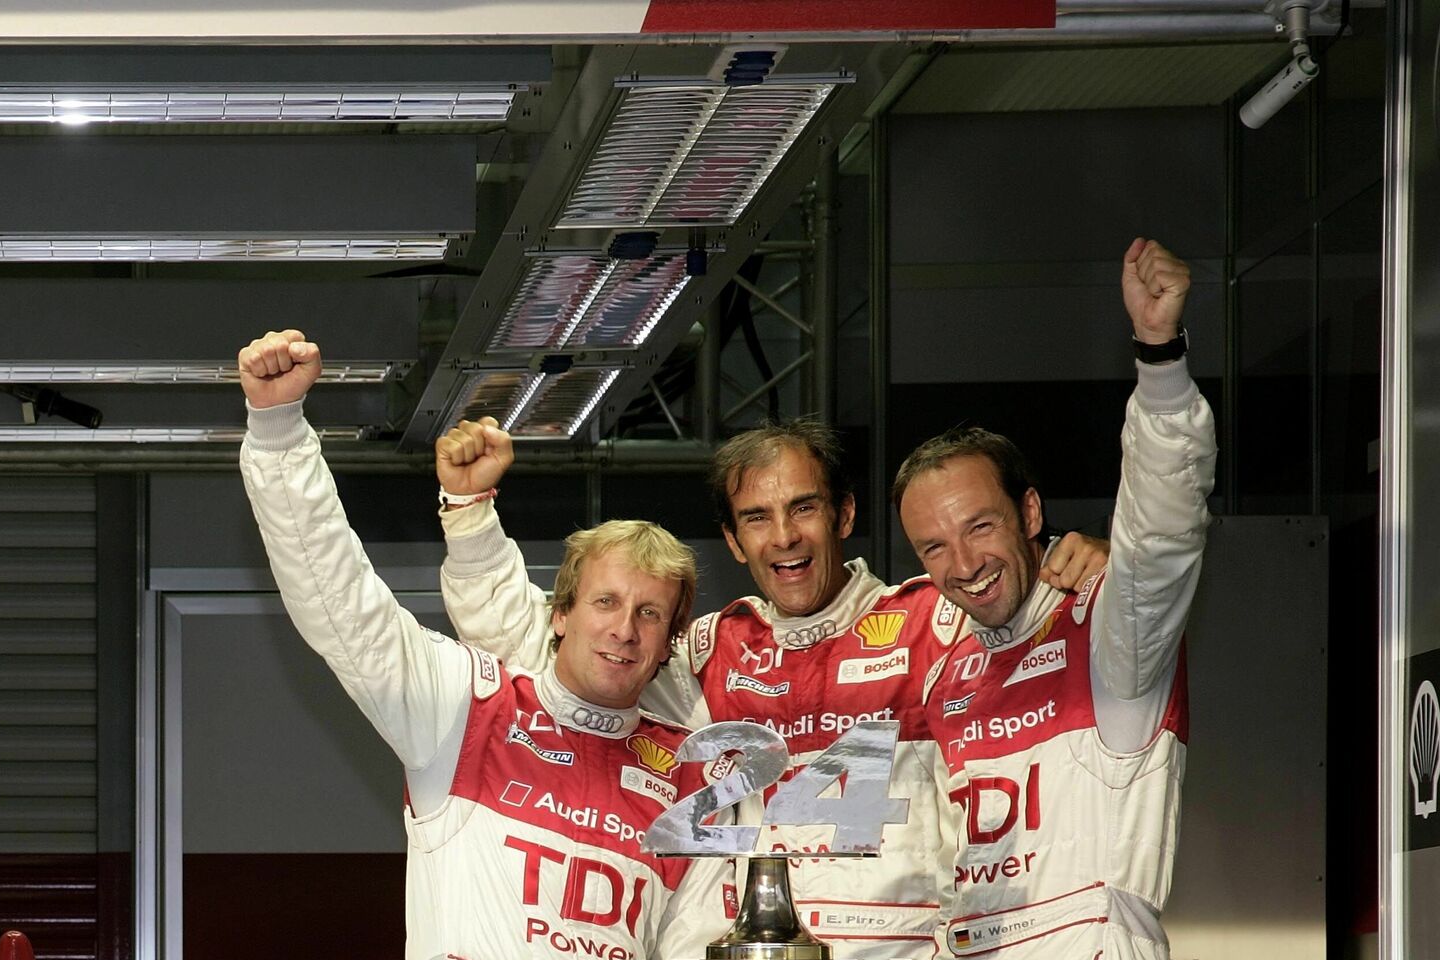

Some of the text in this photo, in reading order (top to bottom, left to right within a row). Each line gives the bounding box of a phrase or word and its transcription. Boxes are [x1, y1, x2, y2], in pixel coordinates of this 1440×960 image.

[863, 655, 906, 675] BOSCH
[1021, 647, 1064, 671] BOSCH
[736, 675, 788, 695] MICHELIN
[989, 699, 1056, 740] Sport
[515, 730, 572, 763] MICHELIN
[644, 778, 677, 804] BOSC
[534, 792, 647, 844] Audi Spo
[504, 834, 648, 939] TDI
[826, 915, 886, 927] E. Pirro
[988, 917, 1036, 937] Werner
